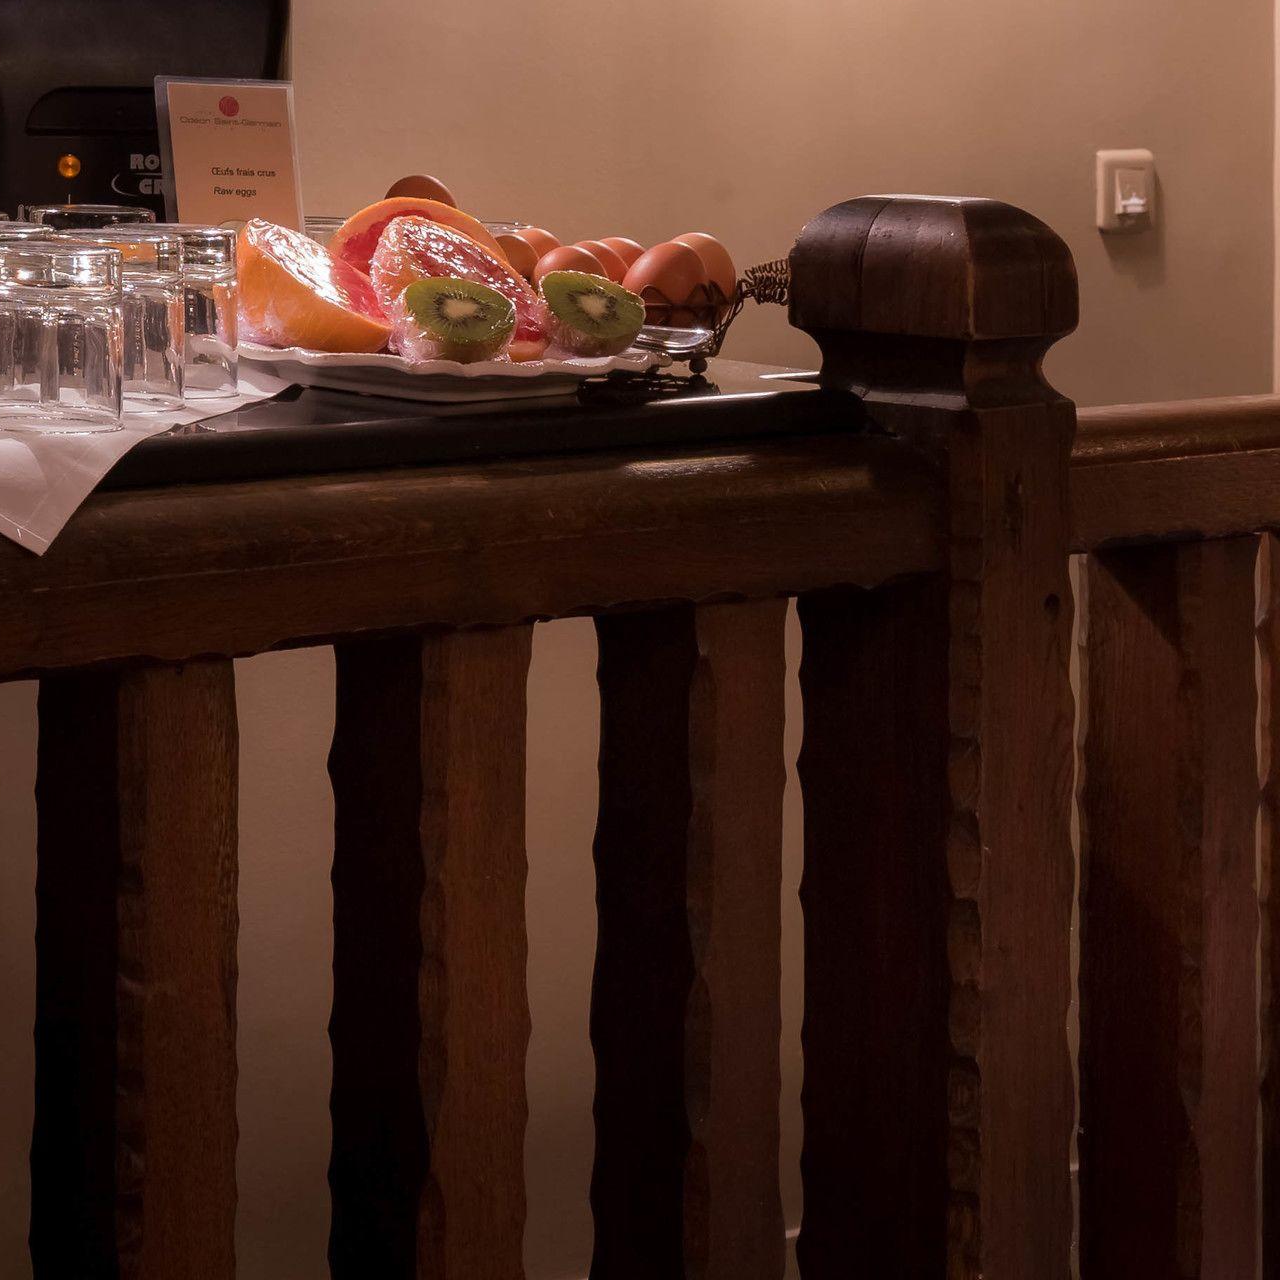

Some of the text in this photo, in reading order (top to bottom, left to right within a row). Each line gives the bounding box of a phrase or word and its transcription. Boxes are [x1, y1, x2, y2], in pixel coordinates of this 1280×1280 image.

[130, 154, 160, 170] RO
[236, 168, 255, 177] frais
[213, 186, 257, 198] Raw eggs
